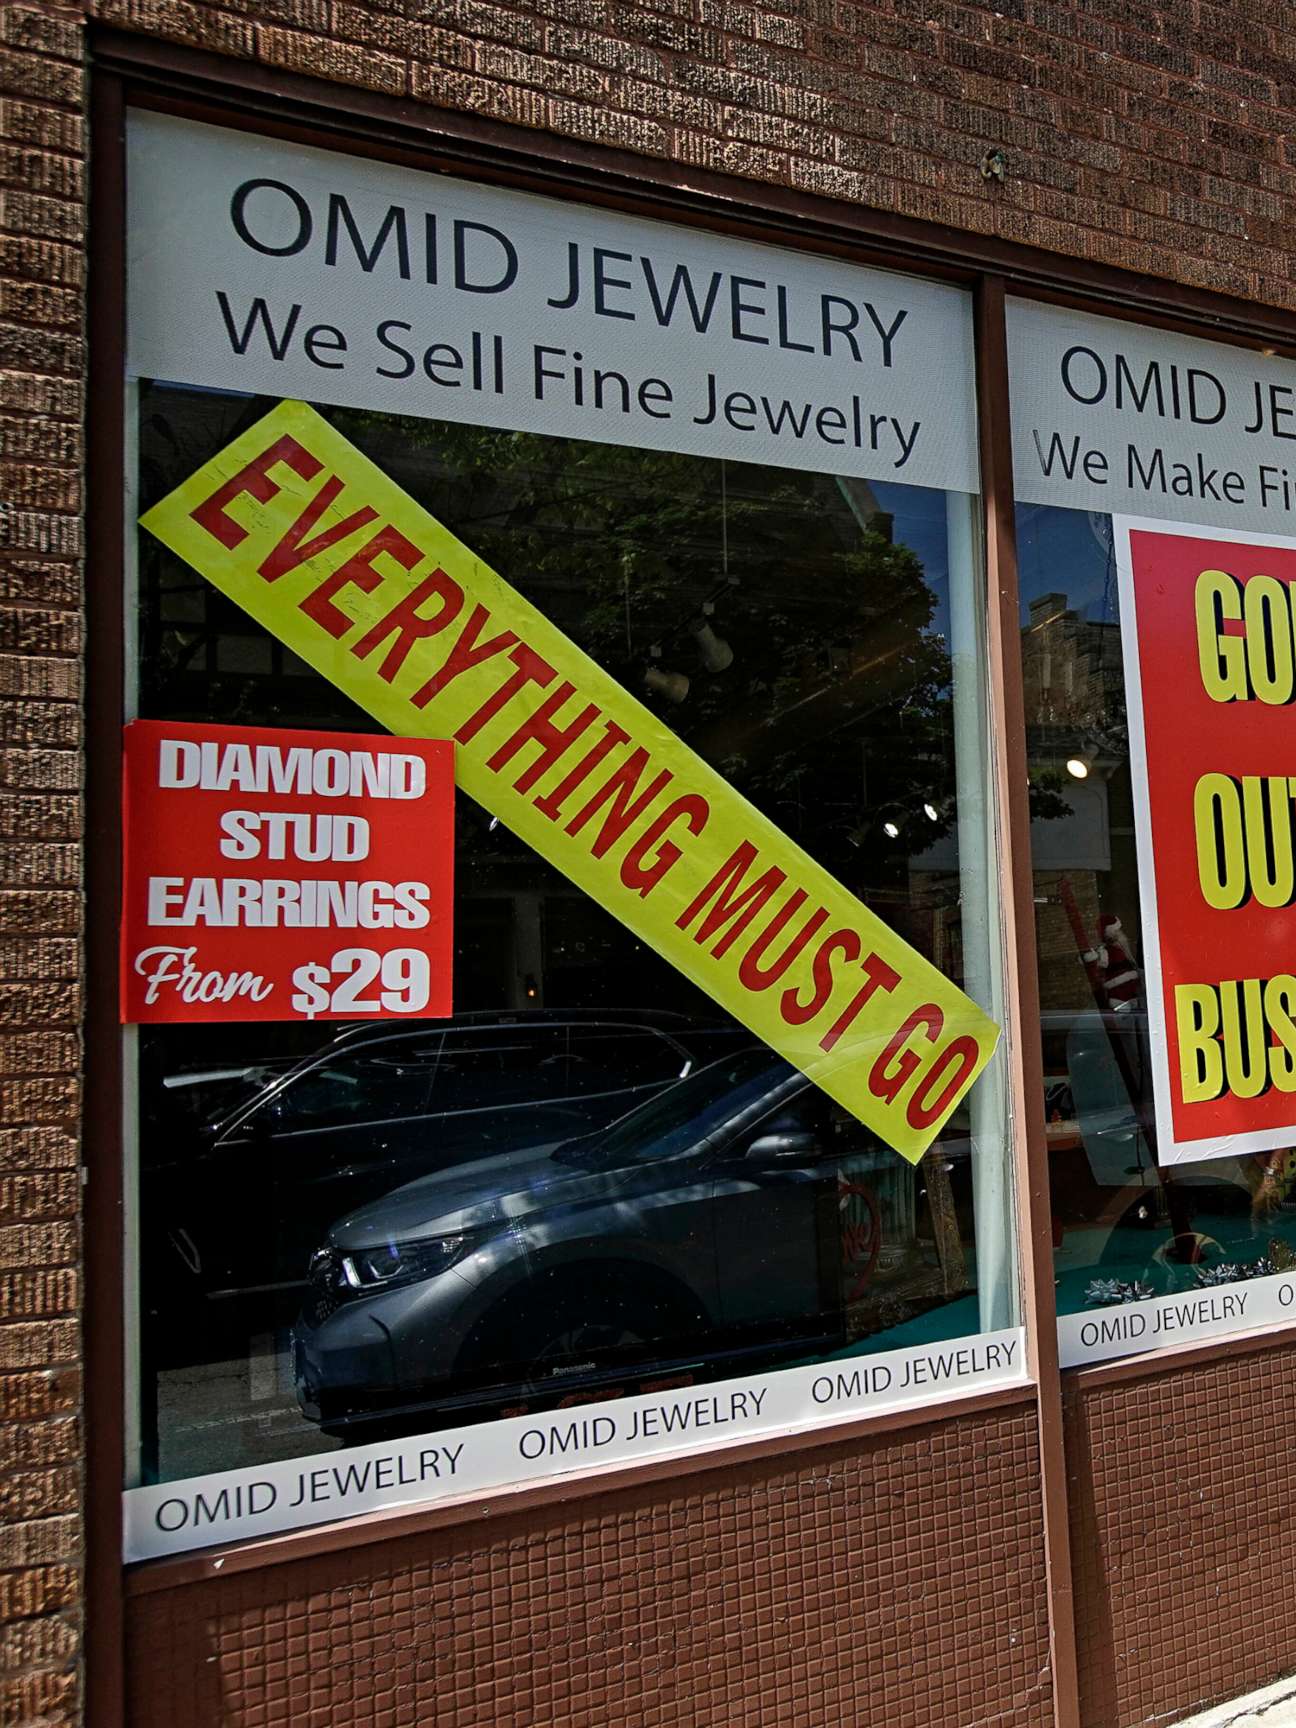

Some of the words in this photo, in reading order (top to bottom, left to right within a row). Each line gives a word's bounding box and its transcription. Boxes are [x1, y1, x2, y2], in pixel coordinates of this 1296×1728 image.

[230, 178, 520, 294] OMID
[547, 241, 908, 369] JEWELRY
[215, 290, 349, 371] We
[375, 318, 505, 395] Sell
[534, 344, 675, 420] Fine
[692, 372, 922, 470] Jewelry
[1059, 345, 1227, 427] OMID
[1033, 430, 1109, 487] We
[1127, 445, 1246, 507] Make
[158, 738, 428, 802] DIAMOND
[188, 432, 711, 900] EVERYTHING
[675, 838, 903, 1056] MUST
[867, 1003, 980, 1131] GO
[220, 811, 371, 863] STUD
[146, 876, 432, 931] EARRINGS
[133, 944, 275, 1006] From
[292, 946, 432, 1021] $29
[1080, 1311, 1148, 1349] OMID
[1153, 1291, 1250, 1338] JEWELRY
[810, 1365, 894, 1405] OMID
[899, 1339, 1018, 1392] JEWELRY
[518, 1415, 615, 1461] OMID
[625, 1387, 769, 1442] JEWELRY
[155, 1480, 279, 1534] OMID
[289, 1443, 466, 1508] JEWELRY
